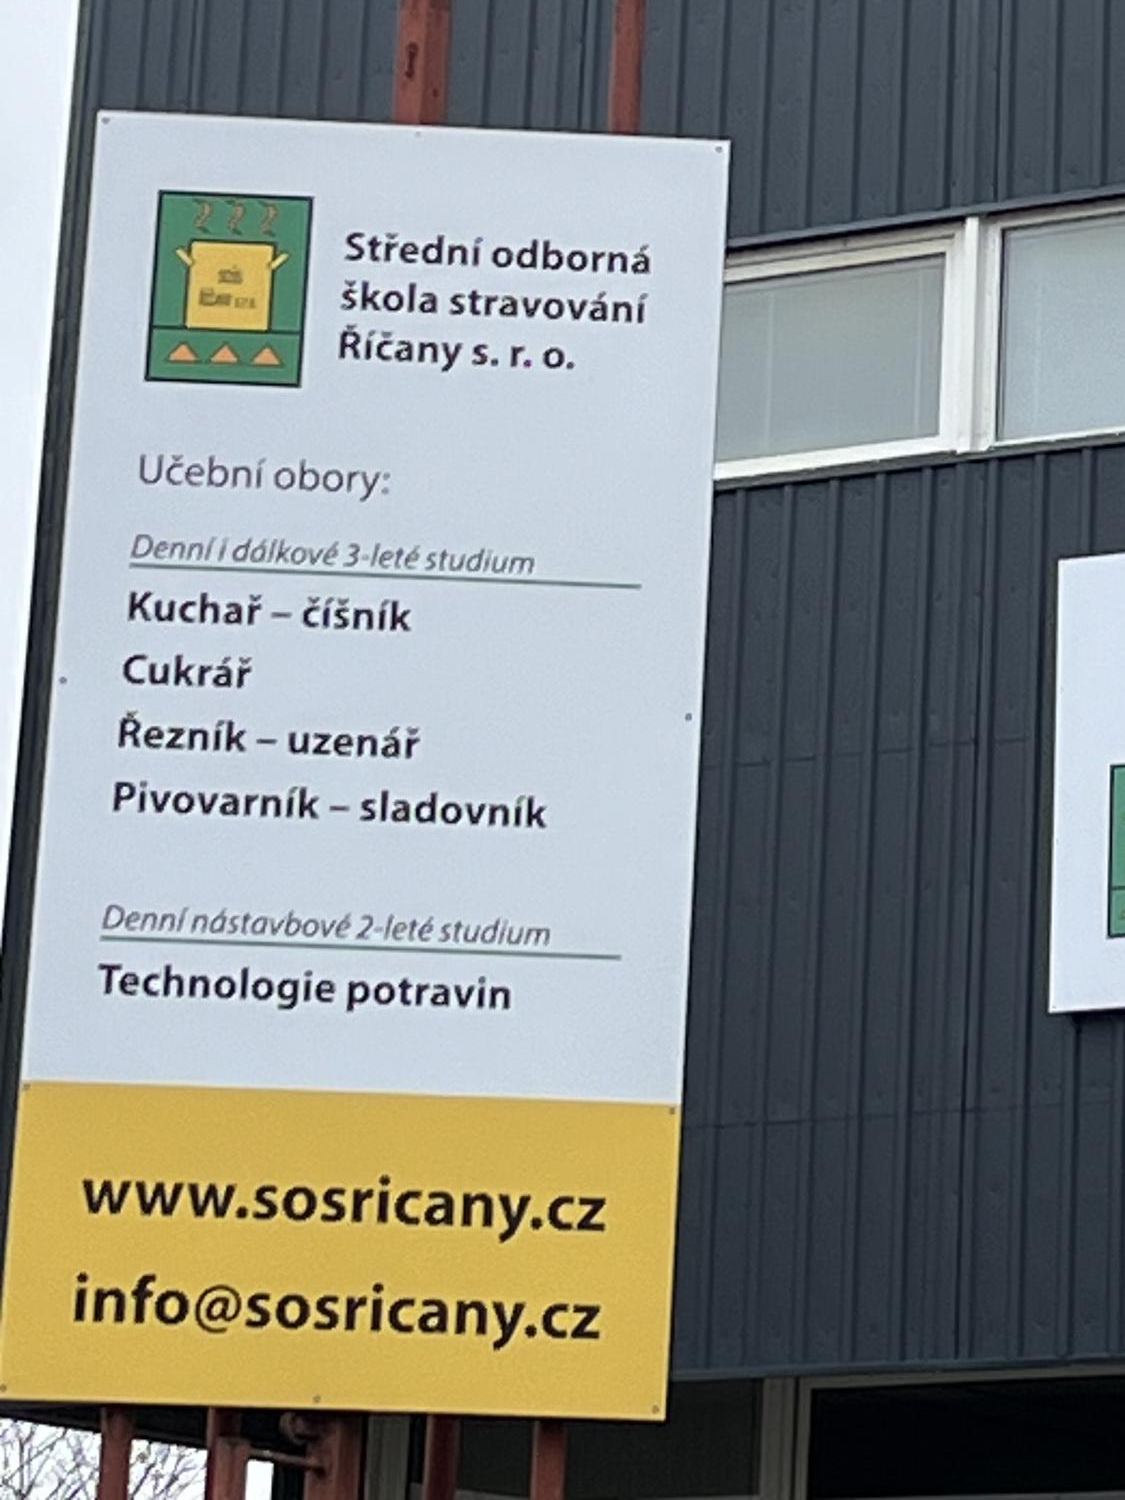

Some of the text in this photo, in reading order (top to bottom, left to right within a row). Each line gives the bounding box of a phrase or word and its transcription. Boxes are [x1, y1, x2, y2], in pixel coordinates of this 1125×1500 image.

[345, 232, 651, 274] Střední odborná
[341, 280, 648, 324] škola stravování
[338, 324, 575, 372] Říčany s. r. o.
[139, 453, 392, 502] Učební obory:
[130, 533, 536, 576] Denní i dálkové 3-leté studium
[127, 591, 263, 626] Kuchař
[302, 596, 412, 633] číšník
[122, 653, 253, 688] Cukrář
[117, 710, 247, 752] Řezník
[288, 726, 421, 760] uzenář
[112, 781, 319, 820] Pivovarník
[358, 791, 548, 829] sladovník
[101, 903, 551, 947] Denní nástavbové 2-leté studium
[98, 963, 513, 1012] Technologie potravin
[81, 1174, 607, 1243] www.sosricany.cz
[72, 1272, 601, 1351] info@sosricany.cz
